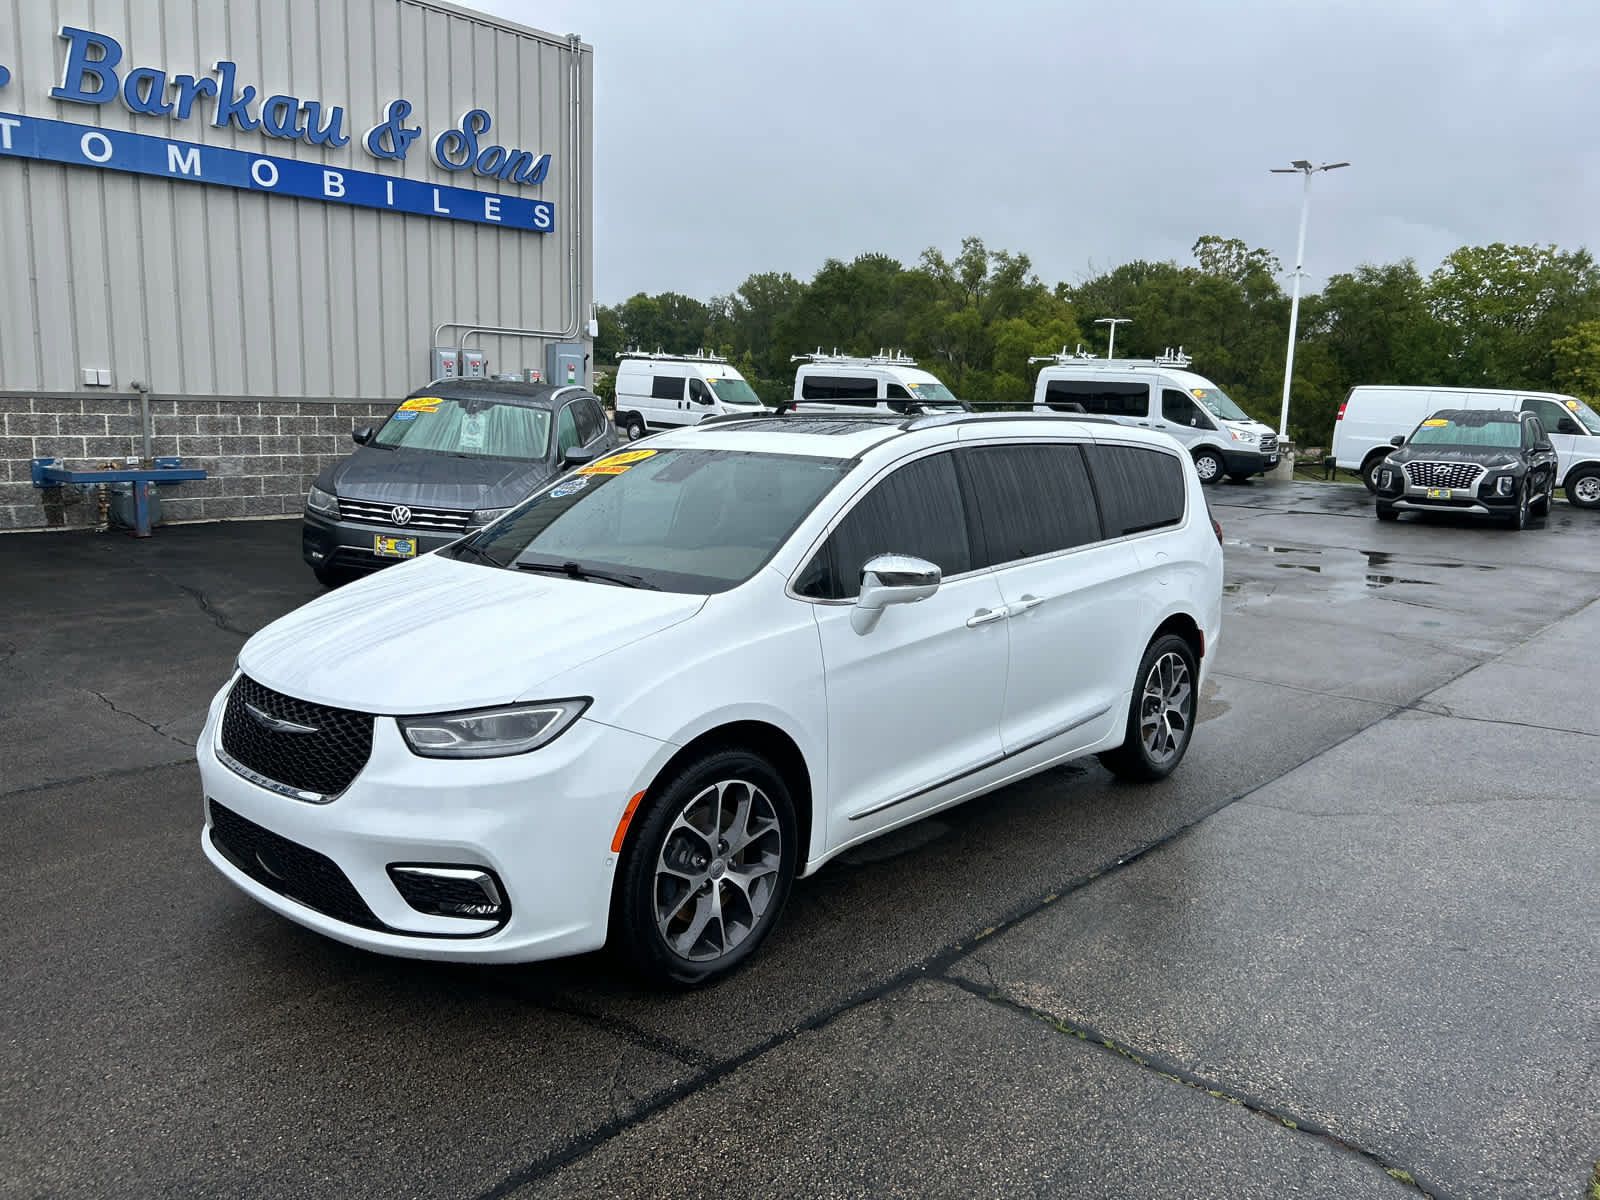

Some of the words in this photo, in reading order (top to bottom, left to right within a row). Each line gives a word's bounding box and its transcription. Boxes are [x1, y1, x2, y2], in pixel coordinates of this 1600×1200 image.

[49, 25, 350, 149] Barkau
[362, 98, 421, 161] &
[431, 107, 551, 186] Sons
